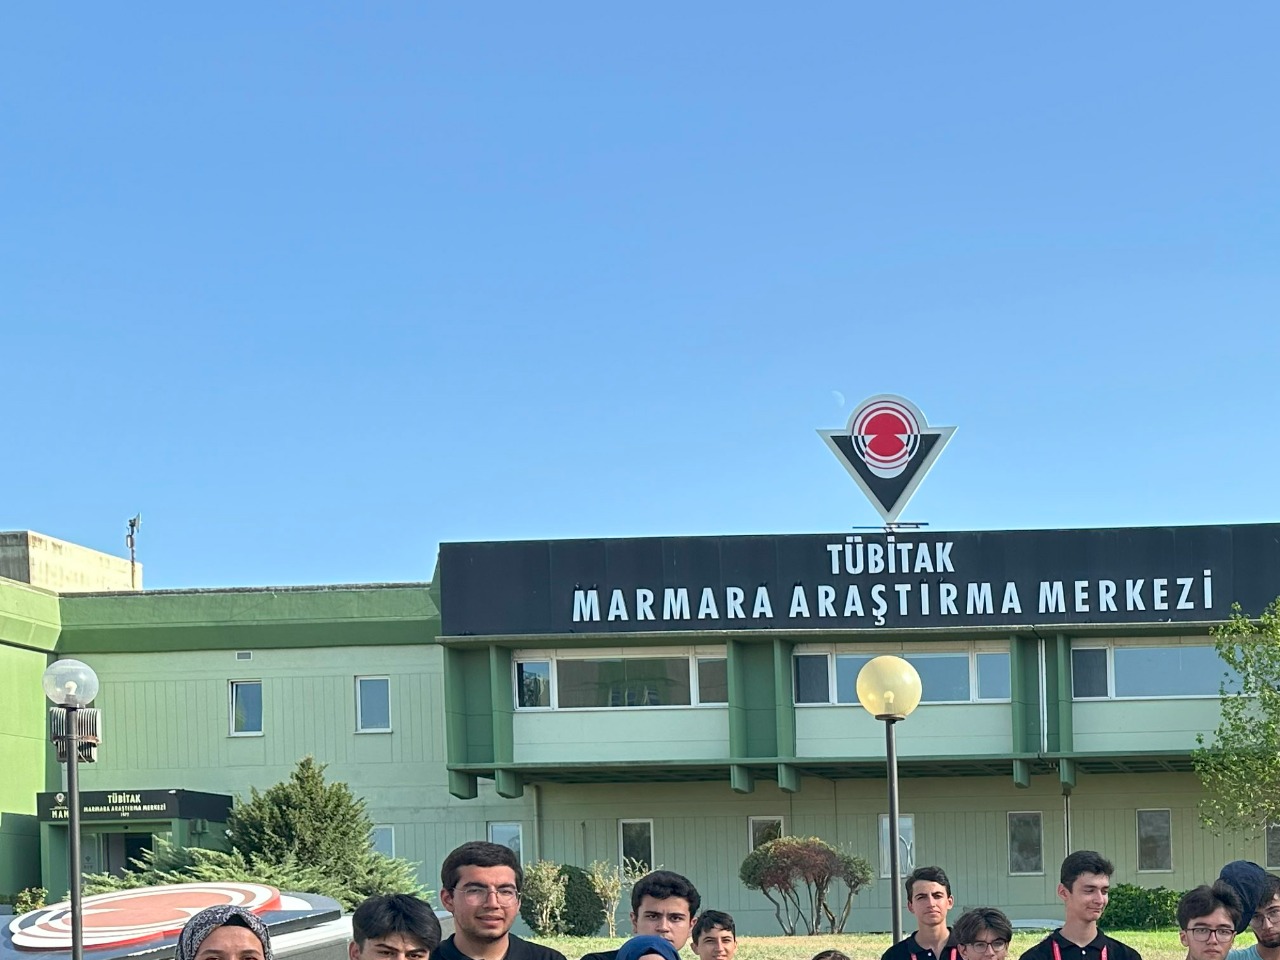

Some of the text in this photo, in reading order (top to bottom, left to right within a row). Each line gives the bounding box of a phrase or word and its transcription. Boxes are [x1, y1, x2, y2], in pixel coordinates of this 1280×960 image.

[827, 536, 955, 575] TÜBİTAK
[572, 569, 1213, 626] MARMARA ARAŞTIRMA MERKEZİ
[83, 805, 111, 813] MARMARA
[107, 792, 141, 804] TÜBİTAK
